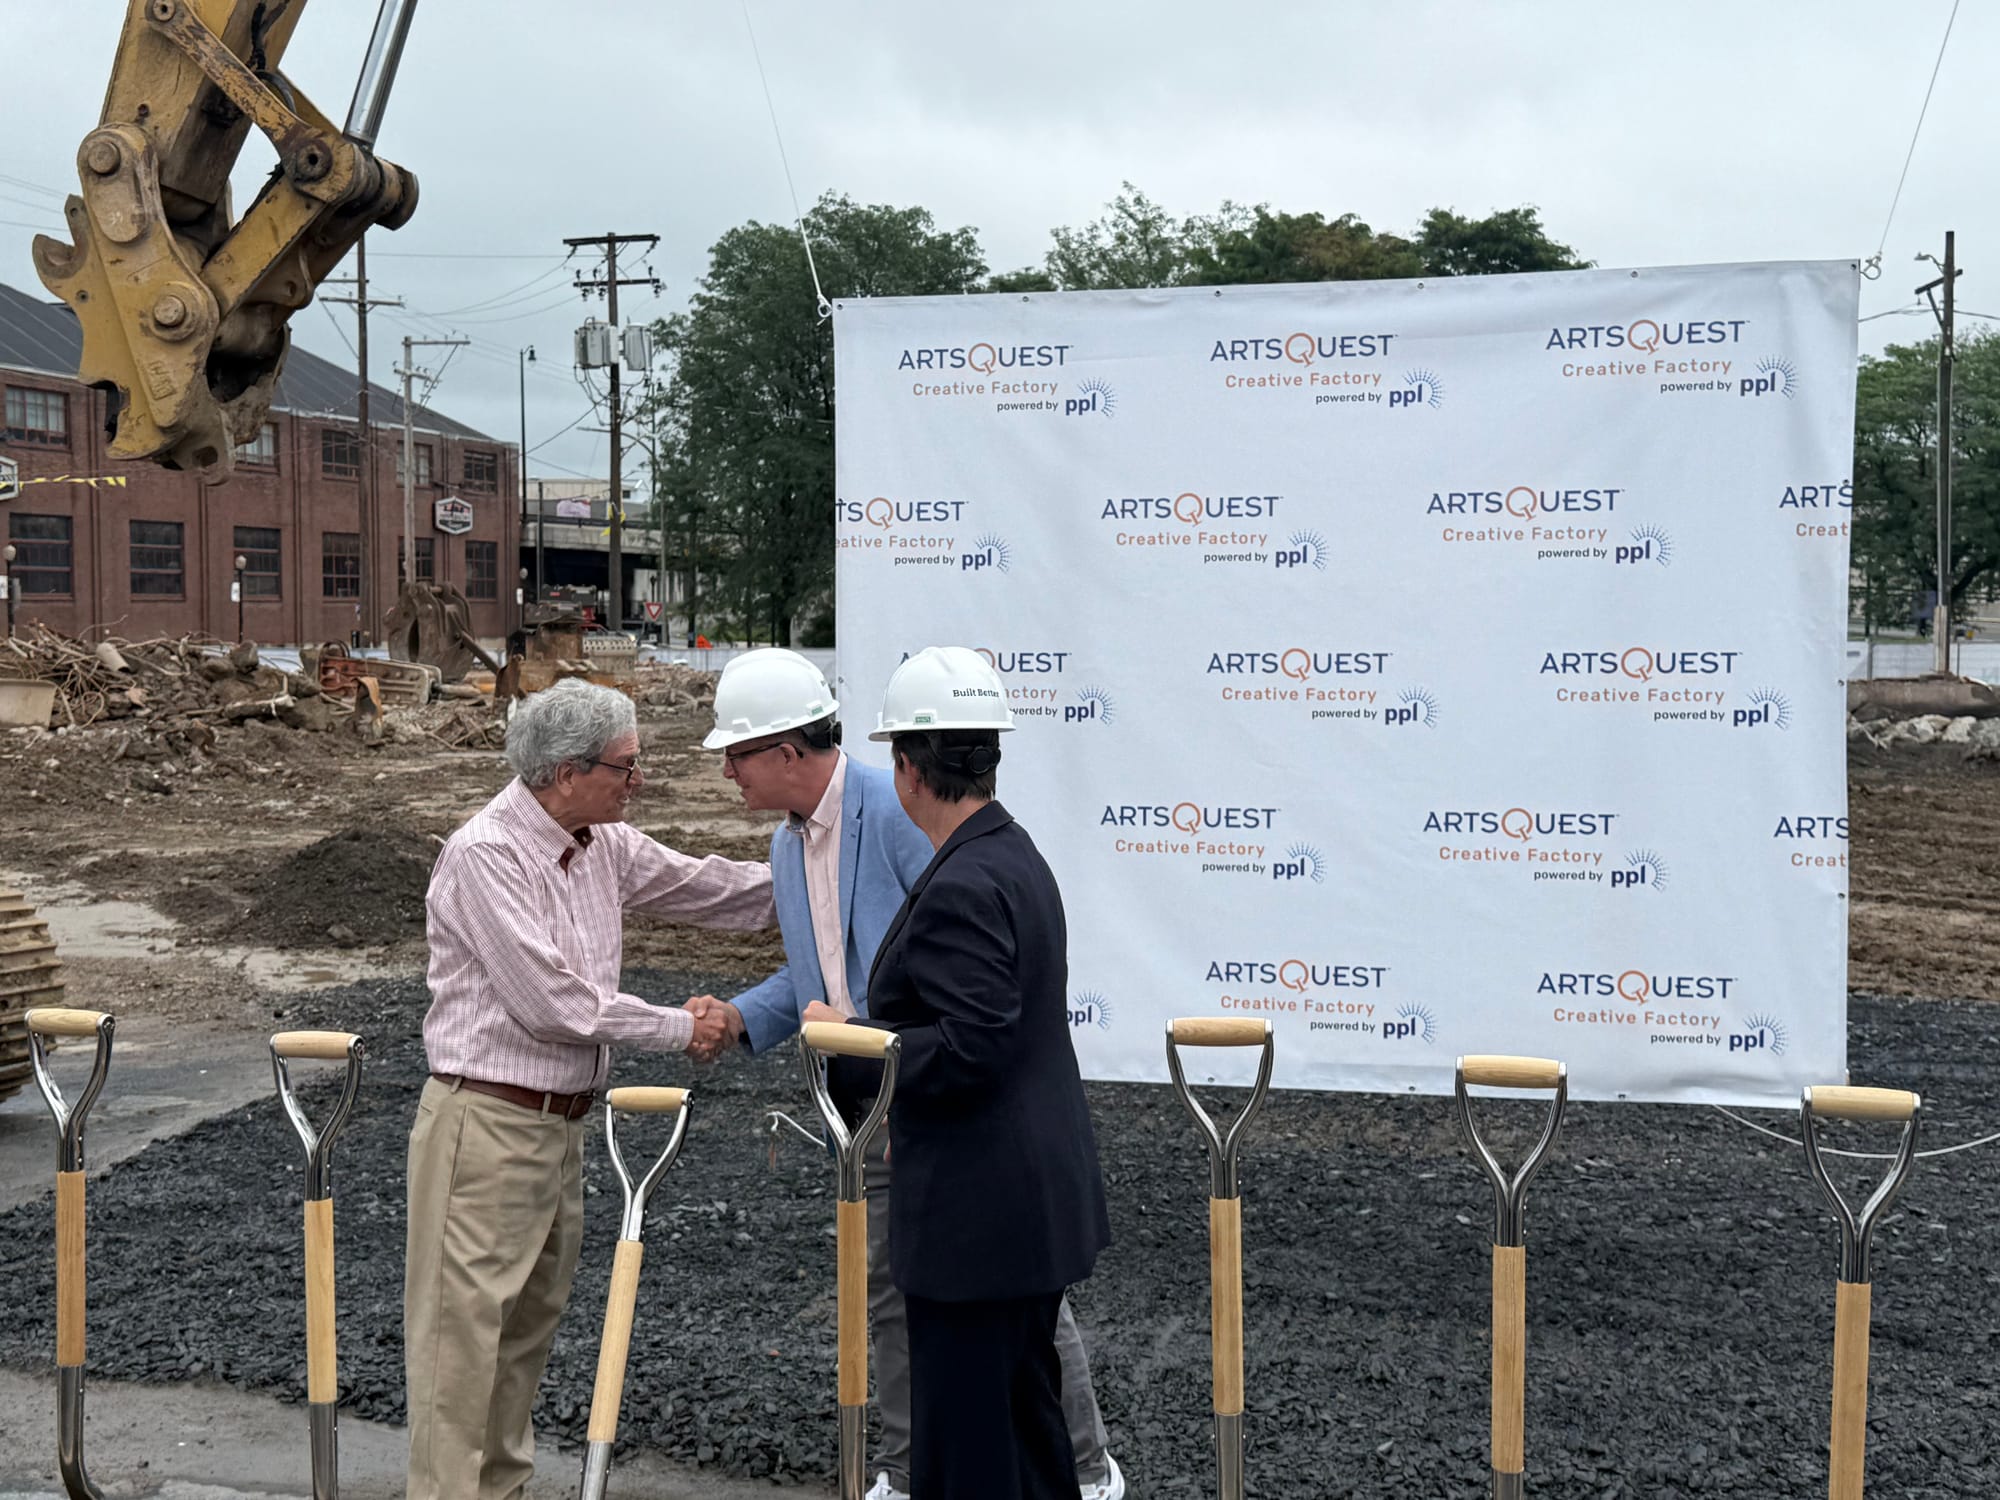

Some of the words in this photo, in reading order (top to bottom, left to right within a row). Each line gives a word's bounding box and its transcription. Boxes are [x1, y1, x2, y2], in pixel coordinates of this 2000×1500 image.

[1209, 332, 1395, 368] ARTSQUEST
[1545, 319, 1746, 356] ARTSQUEST
[897, 342, 1070, 377] ARTSQUEST
[1562, 360, 1647, 377] Creative
[1654, 358, 1732, 375] Factory
[912, 381, 985, 396] Creative
[991, 380, 1058, 396] Factory
[1225, 373, 1303, 388] Creative
[1310, 371, 1382, 388] Factory
[1659, 380, 1714, 395] powered
[1716, 379, 1733, 393] by
[1739, 371, 1776, 398] ppl
[996, 399, 1043, 414] powered
[1045, 400, 1059, 412] by
[1065, 391, 1097, 417] ppl
[1315, 391, 1366, 406] powered
[1367, 391, 1383, 404] by
[1388, 382, 1423, 409] ppl
[1100, 492, 1280, 528] ARTSQUEST
[1426, 486, 1621, 522] ARTSQUEST
[1116, 532, 1192, 546] Creative
[1198, 531, 1268, 547] Factory
[1442, 527, 1524, 542] Creative
[1531, 525, 1608, 543] Factory
[1795, 522, 1849, 537] Creat
[889, 535, 955, 551] Factory
[1537, 547, 1590, 561] powered
[1592, 547, 1608, 560] by
[1615, 538, 1651, 565] ppl
[894, 554, 940, 567] powered
[942, 554, 956, 567] by
[961, 547, 993, 572] ppl
[1203, 551, 1252, 565] powered
[1253, 551, 1269, 564] by
[1274, 543, 1308, 569] ppl
[1206, 647, 1390, 683] ARTSQUEST
[1539, 646, 1739, 684] ARTSQUEST
[952, 688, 977, 698] Built
[1006, 686, 1058, 702] ctory
[1222, 687, 1299, 701] Creative
[1305, 687, 1377, 704] Factory
[1556, 687, 1640, 702] Creative
[1647, 687, 1725, 706] Factory
[1010, 705, 1043, 716] wered
[1044, 705, 1059, 718] by
[1064, 699, 1096, 723] ppl
[1311, 708, 1361, 721] powered
[1363, 708, 1378, 721] by
[1384, 701, 1418, 726] ppl
[1653, 709, 1708, 723] powered
[1709, 709, 1726, 723] by
[1732, 702, 1769, 728] ppl
[1099, 801, 1278, 837] ARTSQUEST
[1422, 807, 1616, 843] ARTSQUEST
[1115, 839, 1190, 854] Creative
[1196, 841, 1265, 859] Factory
[1439, 846, 1521, 862] Creative
[1527, 848, 1603, 867] Factory
[1790, 852, 1847, 867] Creat
[1201, 862, 1250, 874] powered
[1252, 862, 1266, 876] by
[1272, 856, 1306, 881] ppl
[1533, 869, 1586, 882] powered
[1588, 870, 1604, 883] by
[1610, 863, 1646, 889] ppl
[1205, 959, 1387, 994] ARTSQUEST
[1536, 969, 1734, 1006] ARTSQUEST
[1220, 995, 1297, 1012] Creative
[1304, 999, 1375, 1018] Factory
[1553, 1008, 1637, 1025] Creative
[1644, 1011, 1721, 1030] Factory
[1309, 1021, 1360, 1035] powered
[1361, 1021, 1376, 1035] by
[1382, 1015, 1417, 1041] ppl
[1650, 1033, 1704, 1046] powered
[1706, 1033, 1722, 1047] by
[1728, 1028, 1765, 1053] ppl
